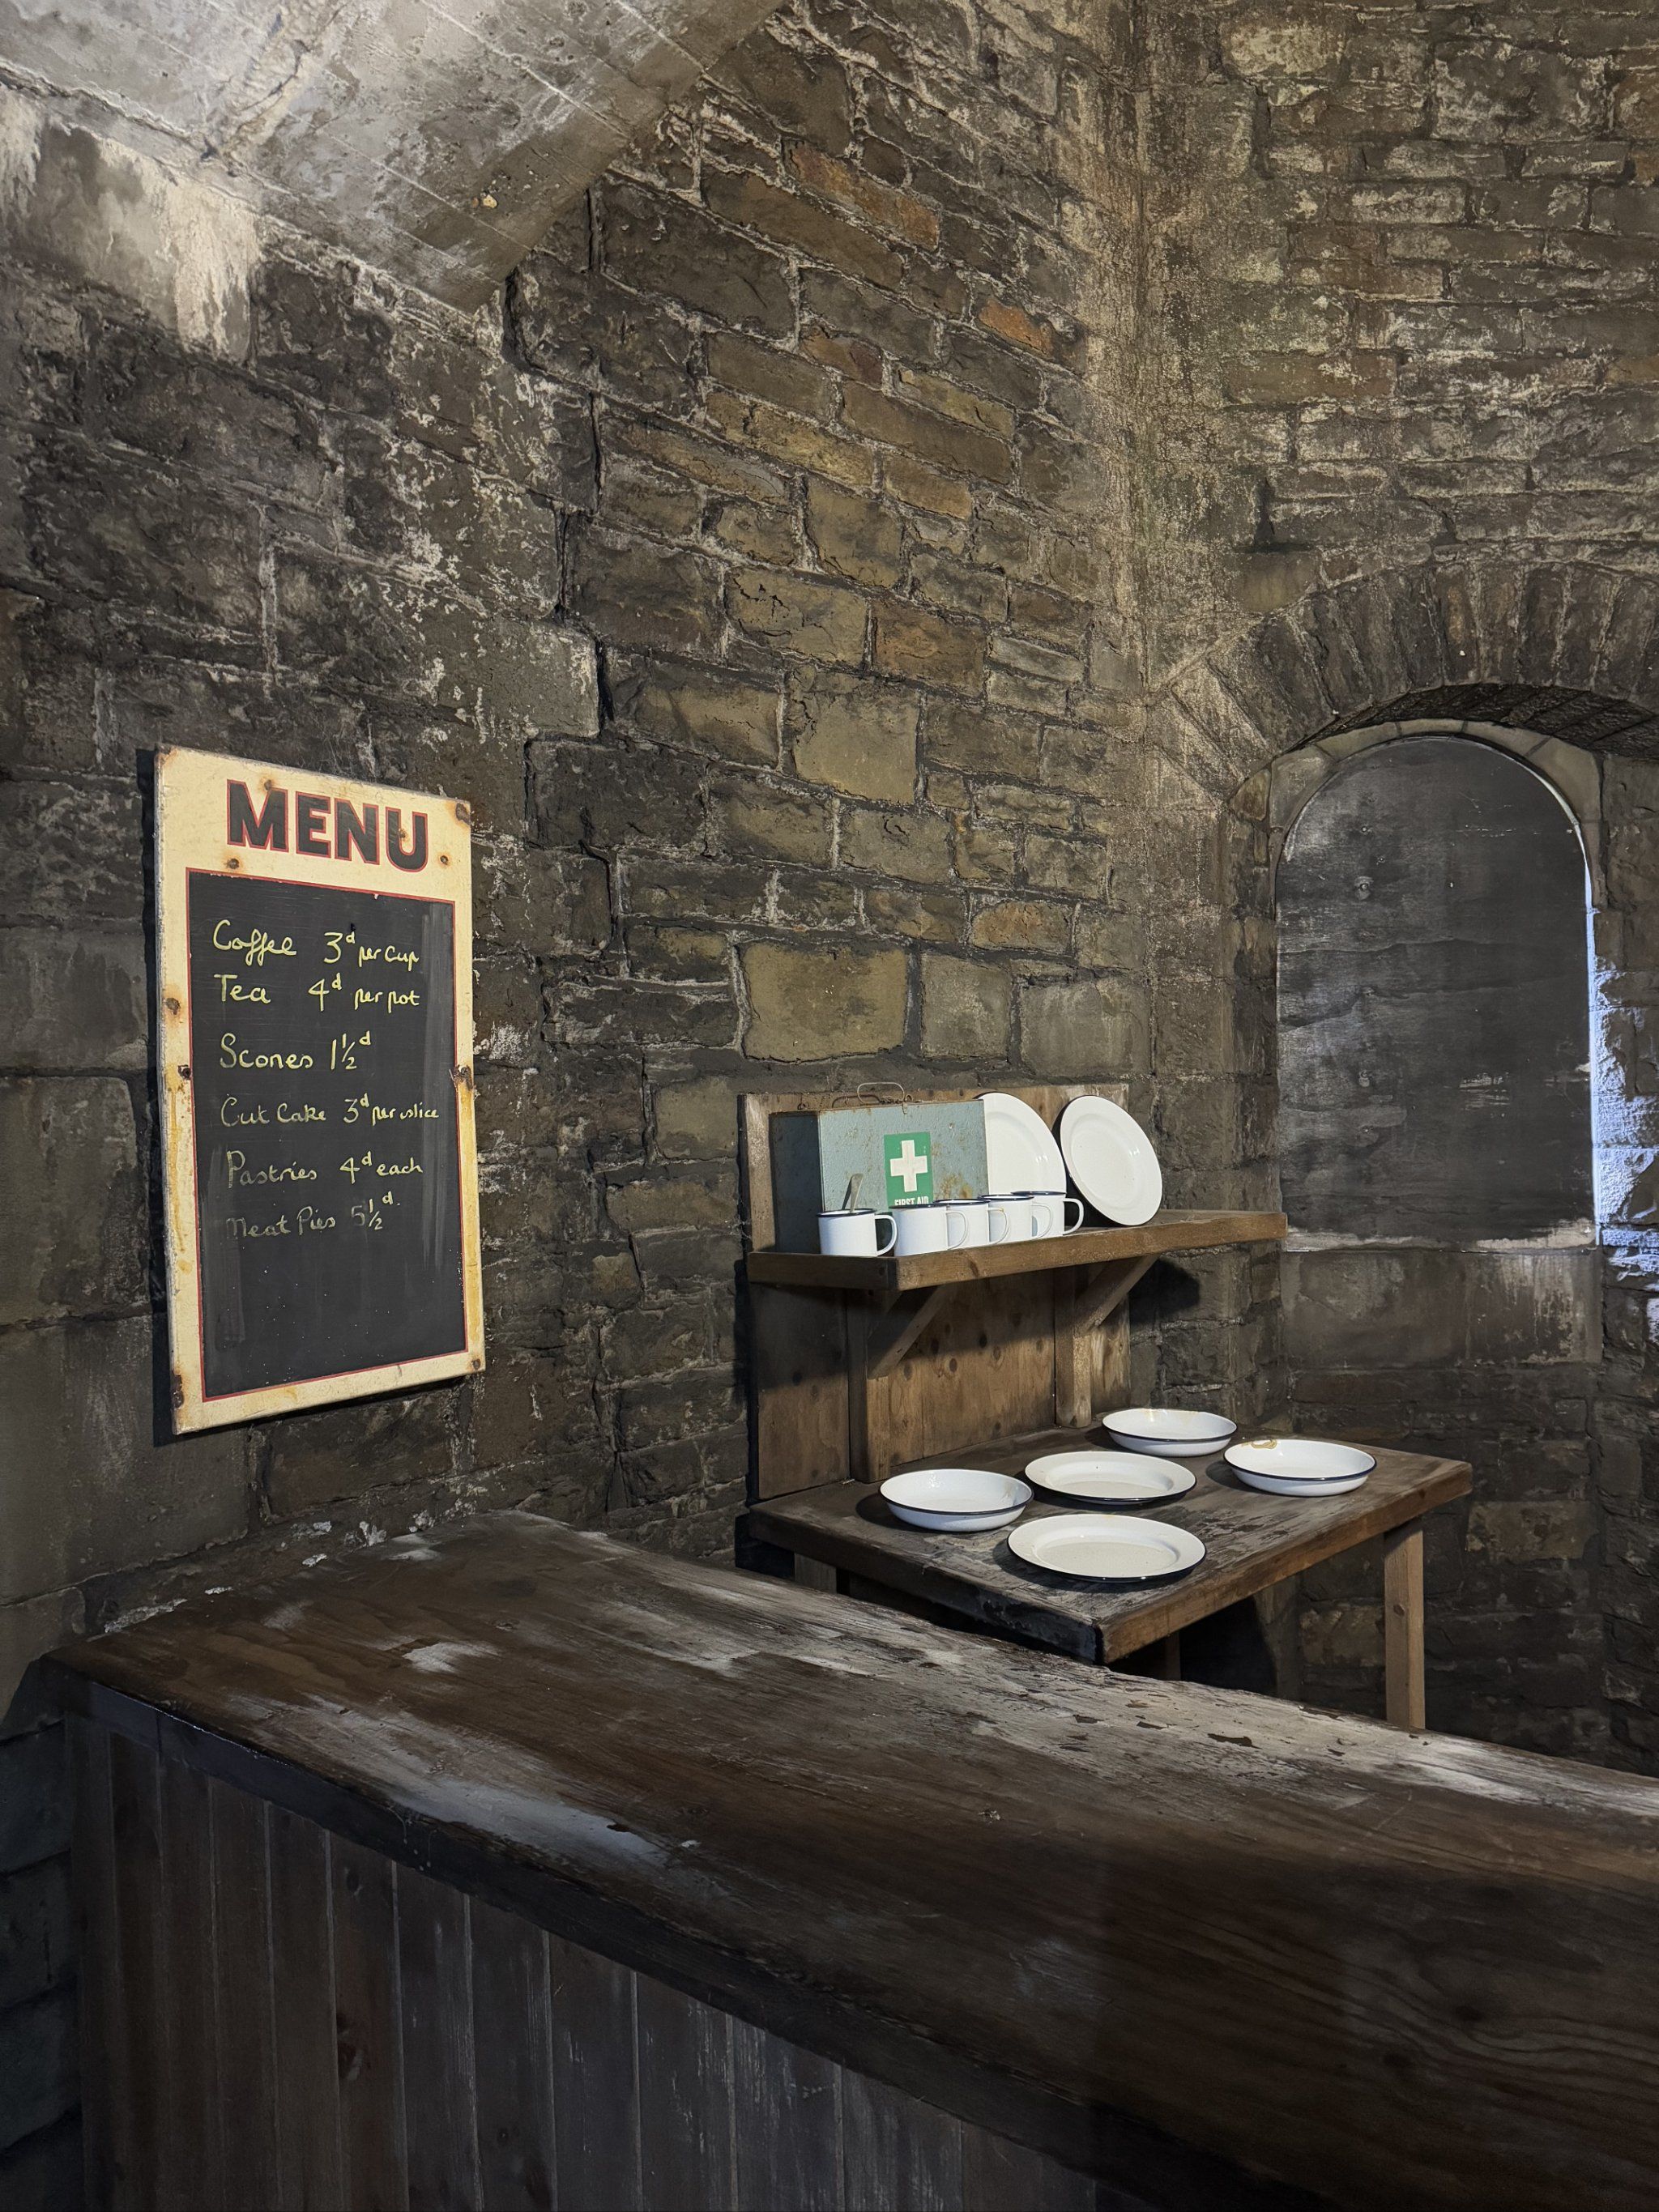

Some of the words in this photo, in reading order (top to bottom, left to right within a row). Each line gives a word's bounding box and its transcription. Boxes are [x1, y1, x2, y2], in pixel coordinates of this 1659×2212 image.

[226, 778, 429, 872] MENU
[213, 919, 296, 966] Coffee
[358, 945, 382, 967] per
[214, 974, 271, 1004] Tea
[355, 988, 382, 1011] per
[387, 991, 420, 1013] pot
[220, 1033, 313, 1070] Scones
[220, 1097, 270, 1127] Cut
[276, 1102, 326, 1124] Cake
[372, 1108, 396, 1126] per
[399, 1102, 439, 1120] slice
[226, 1150, 317, 1189] Pastries
[377, 1157, 423, 1176] each
[894, 1197, 915, 1205] FIRST
[917, 1196, 929, 1204] AID
[225, 1214, 291, 1239] Meat
[296, 1206, 336, 1235] Pies
